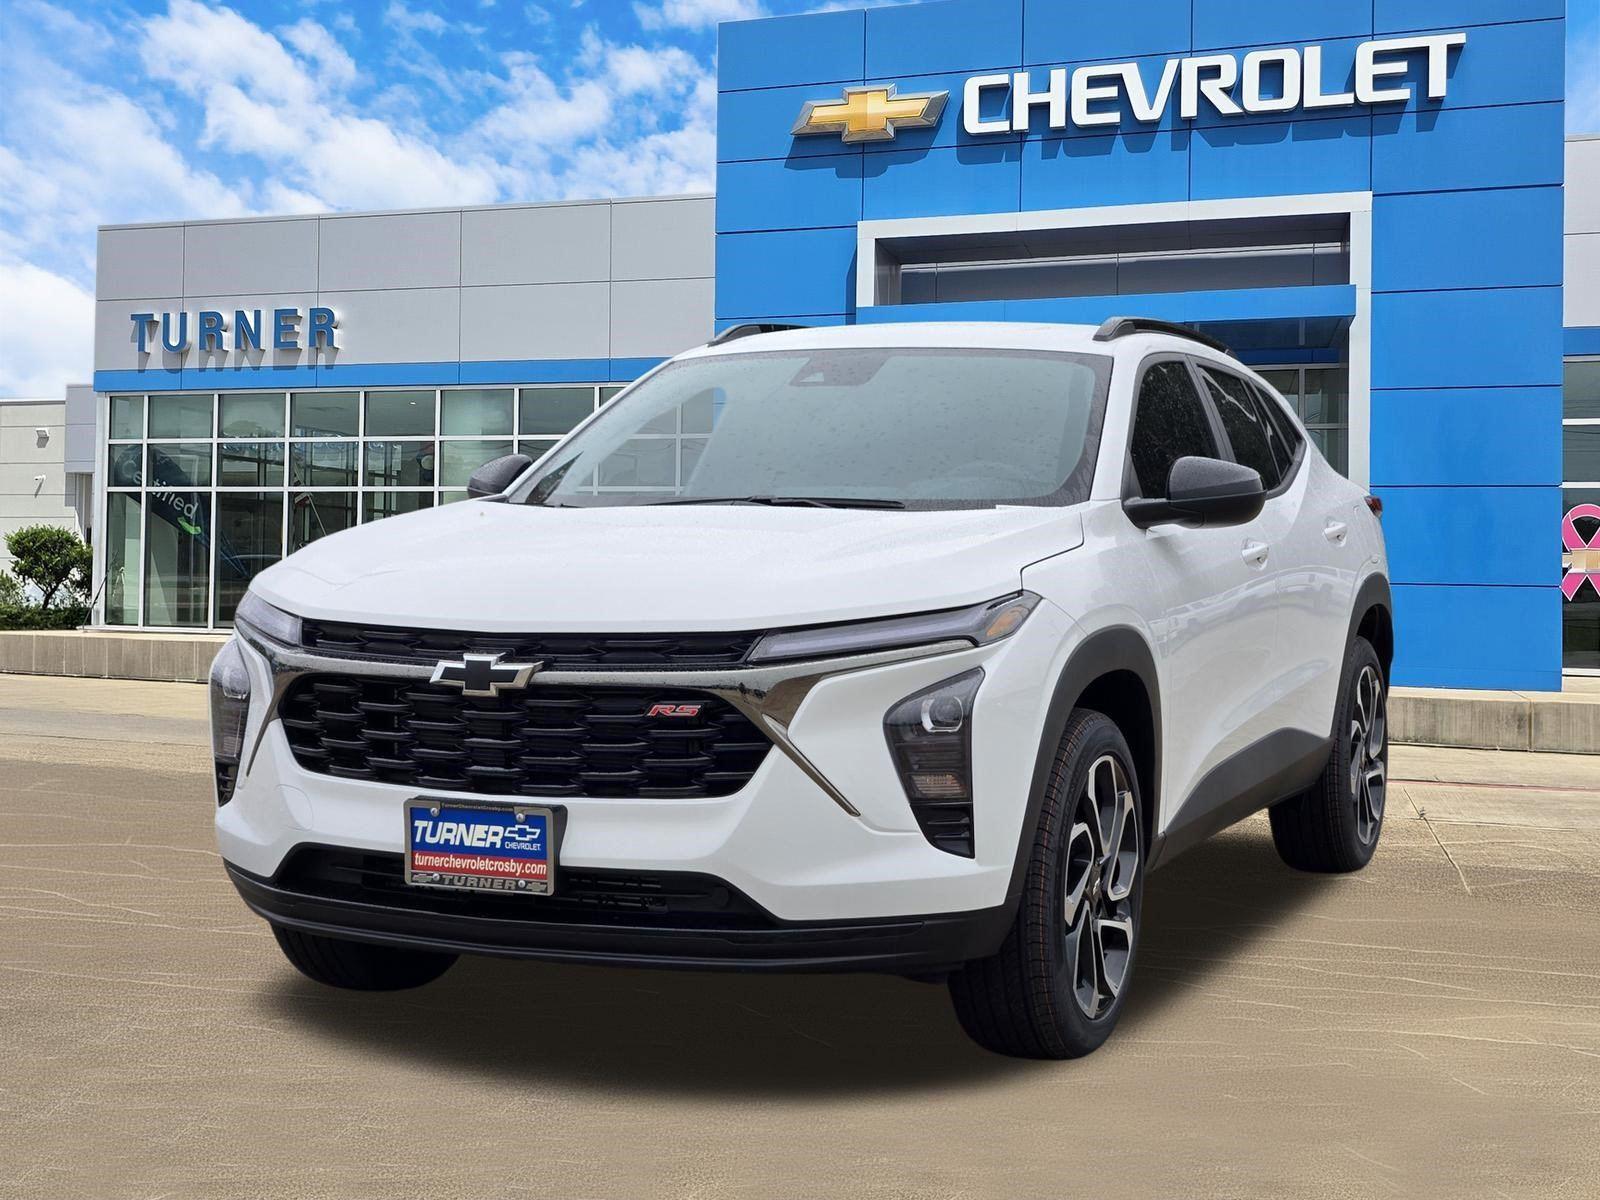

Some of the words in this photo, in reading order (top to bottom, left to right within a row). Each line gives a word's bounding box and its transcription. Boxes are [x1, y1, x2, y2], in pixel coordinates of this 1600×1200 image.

[962, 32, 1467, 136] CHEVROLET
[130, 307, 338, 352] TURNER
[122, 459, 199, 519] Cetified
[647, 704, 701, 717] RS
[414, 820, 505, 849] TURNER
[505, 841, 542, 851] CHEVROLET
[414, 852, 548, 876] turnerchevroletcrosby.com
[442, 874, 517, 891] TURNER
